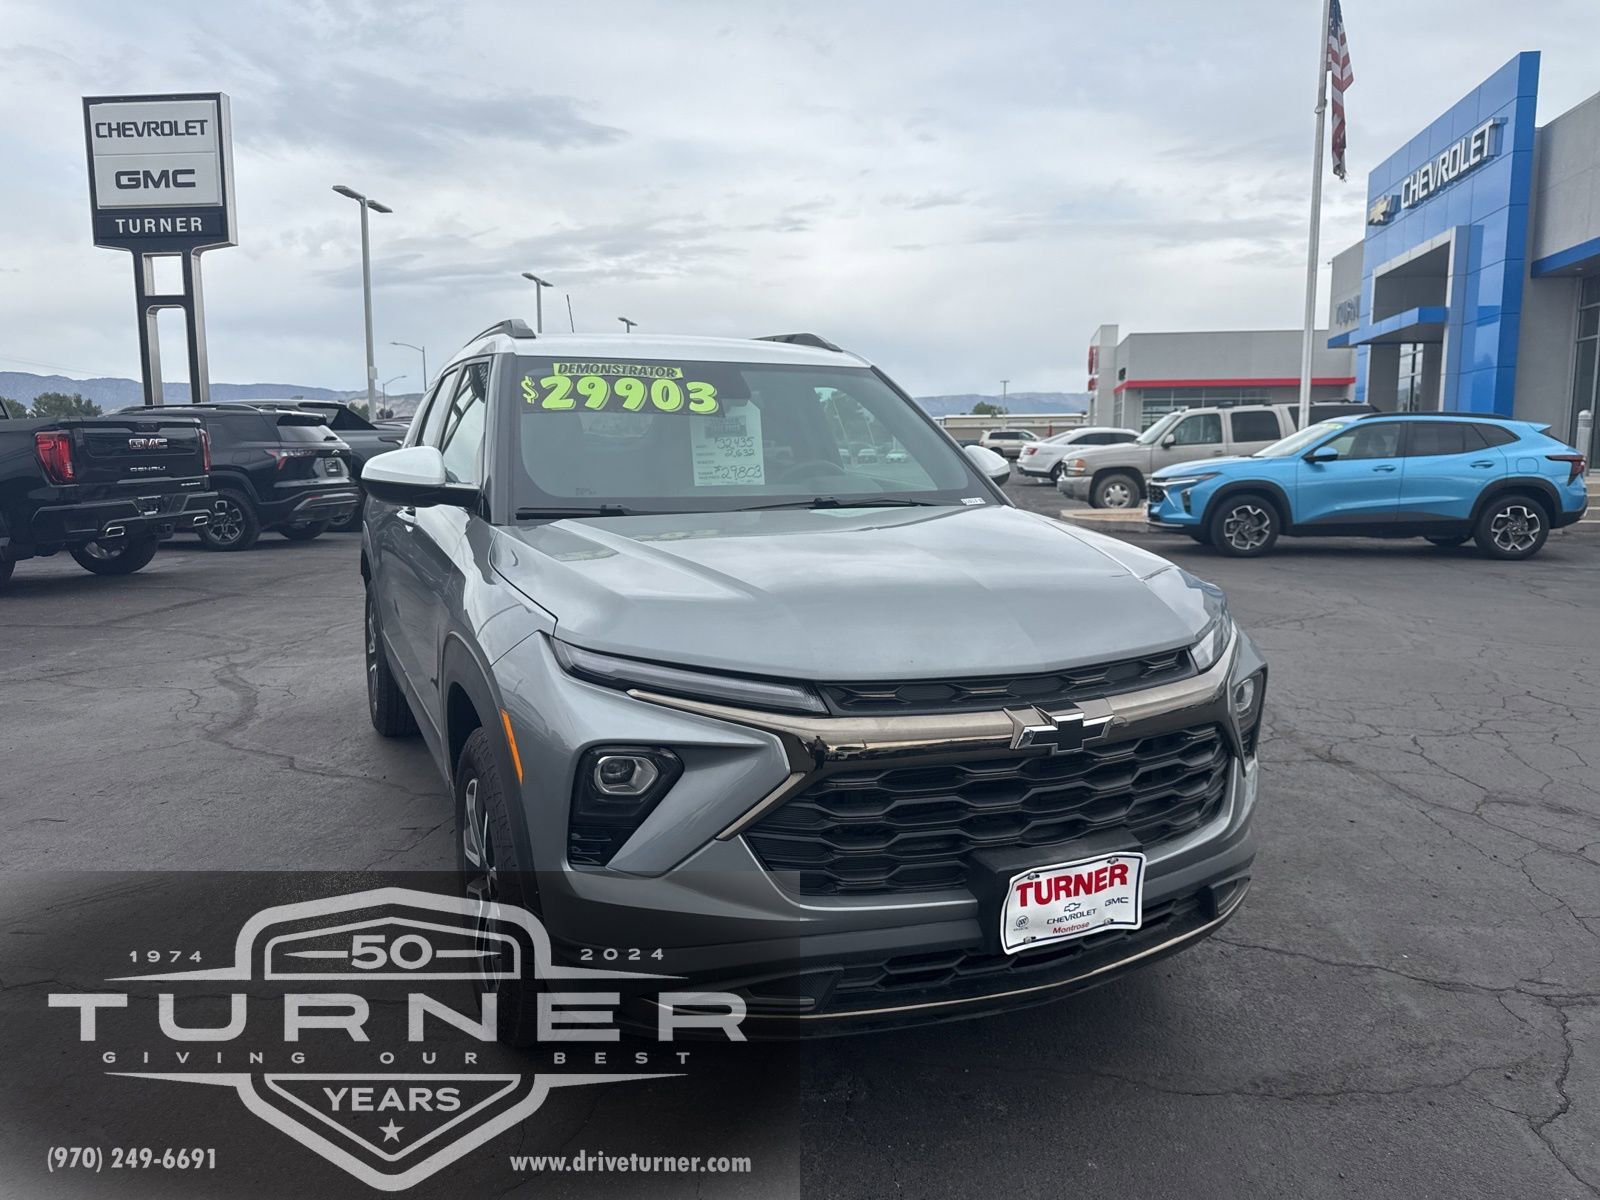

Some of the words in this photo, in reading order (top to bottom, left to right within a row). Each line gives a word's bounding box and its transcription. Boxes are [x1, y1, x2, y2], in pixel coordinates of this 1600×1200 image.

[95, 119, 208, 139] CHEVROLET
[1401, 118, 1497, 209] CHEVROLET
[115, 169, 196, 189] GMC
[115, 217, 203, 234] TURNER
[557, 363, 679, 378] DEMONSTRATOR
[129, 438, 168, 450] GMC
[1015, 864, 1128, 907] TURNER
[1104, 897, 1128, 907] GMC
[1046, 908, 1097, 924] CHEVROLET
[1052, 921, 1090, 934] Montrose
